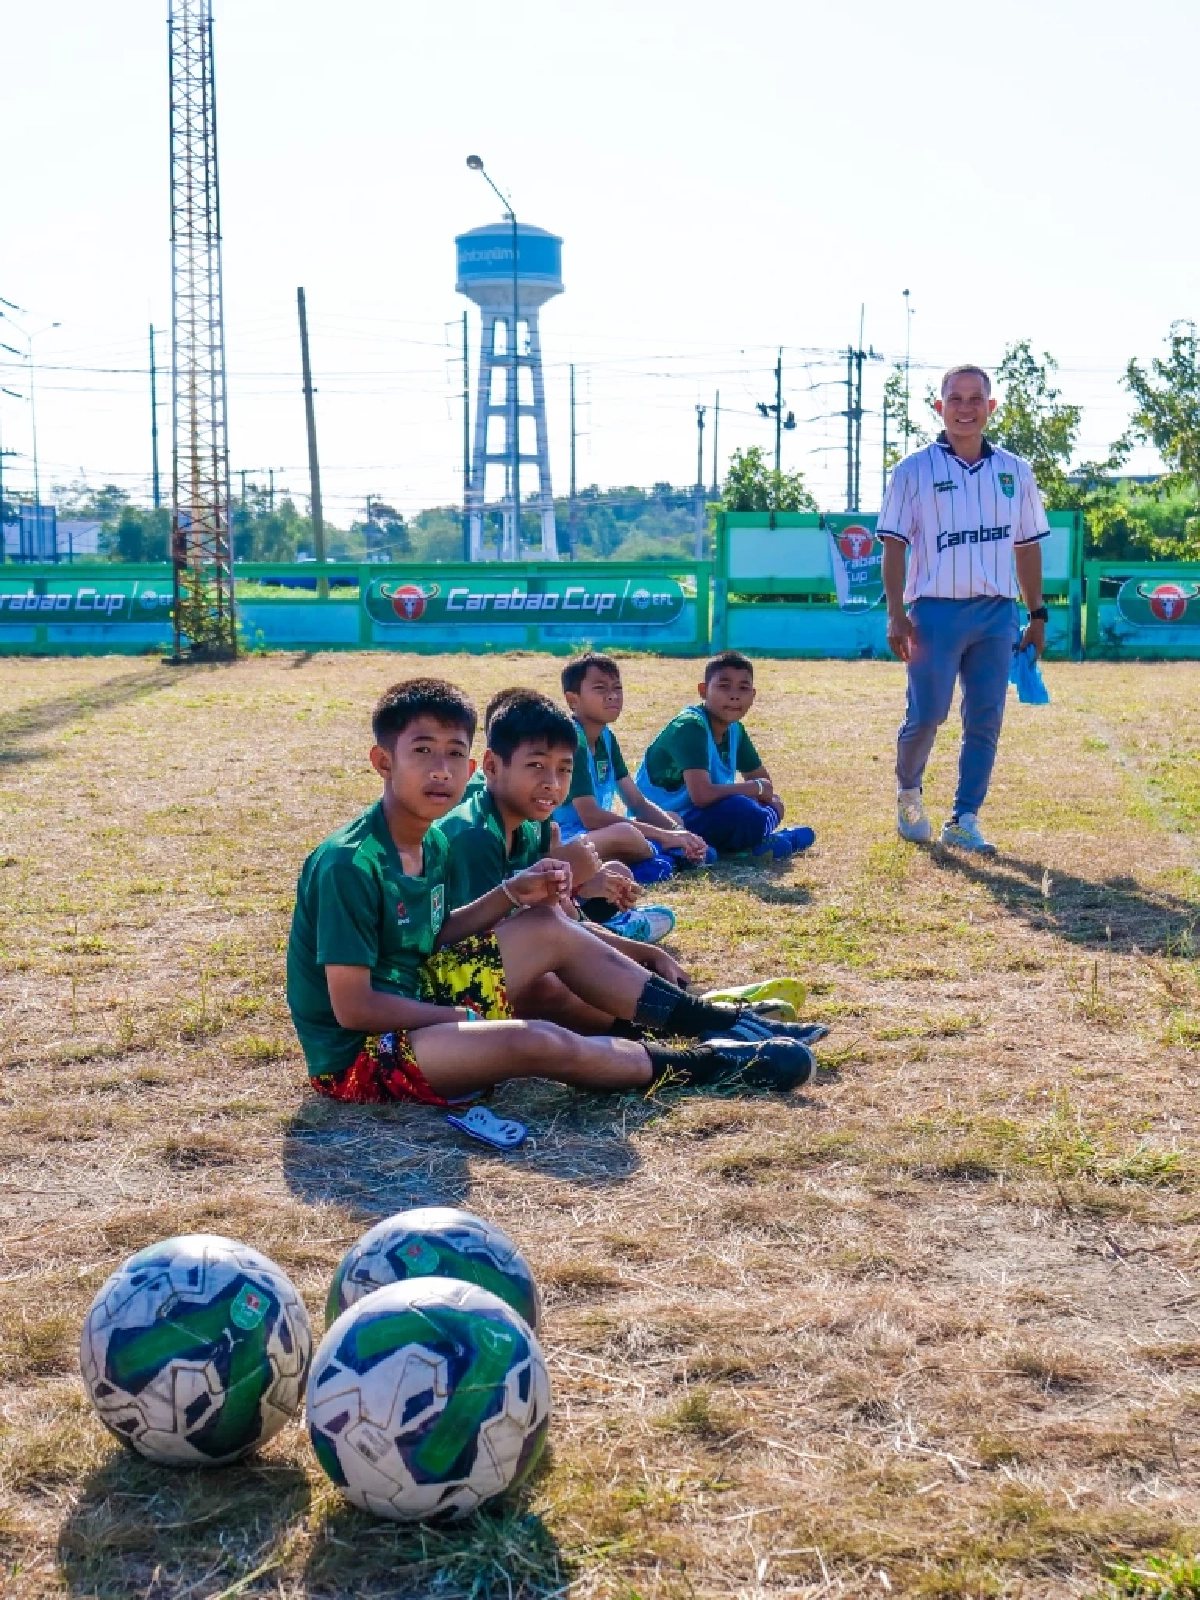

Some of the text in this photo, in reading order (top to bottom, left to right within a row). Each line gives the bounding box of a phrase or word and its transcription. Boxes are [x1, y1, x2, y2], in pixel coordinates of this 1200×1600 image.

[75, 587, 125, 616] Cup
[446, 587, 674, 616] Carabao Cup EFL
